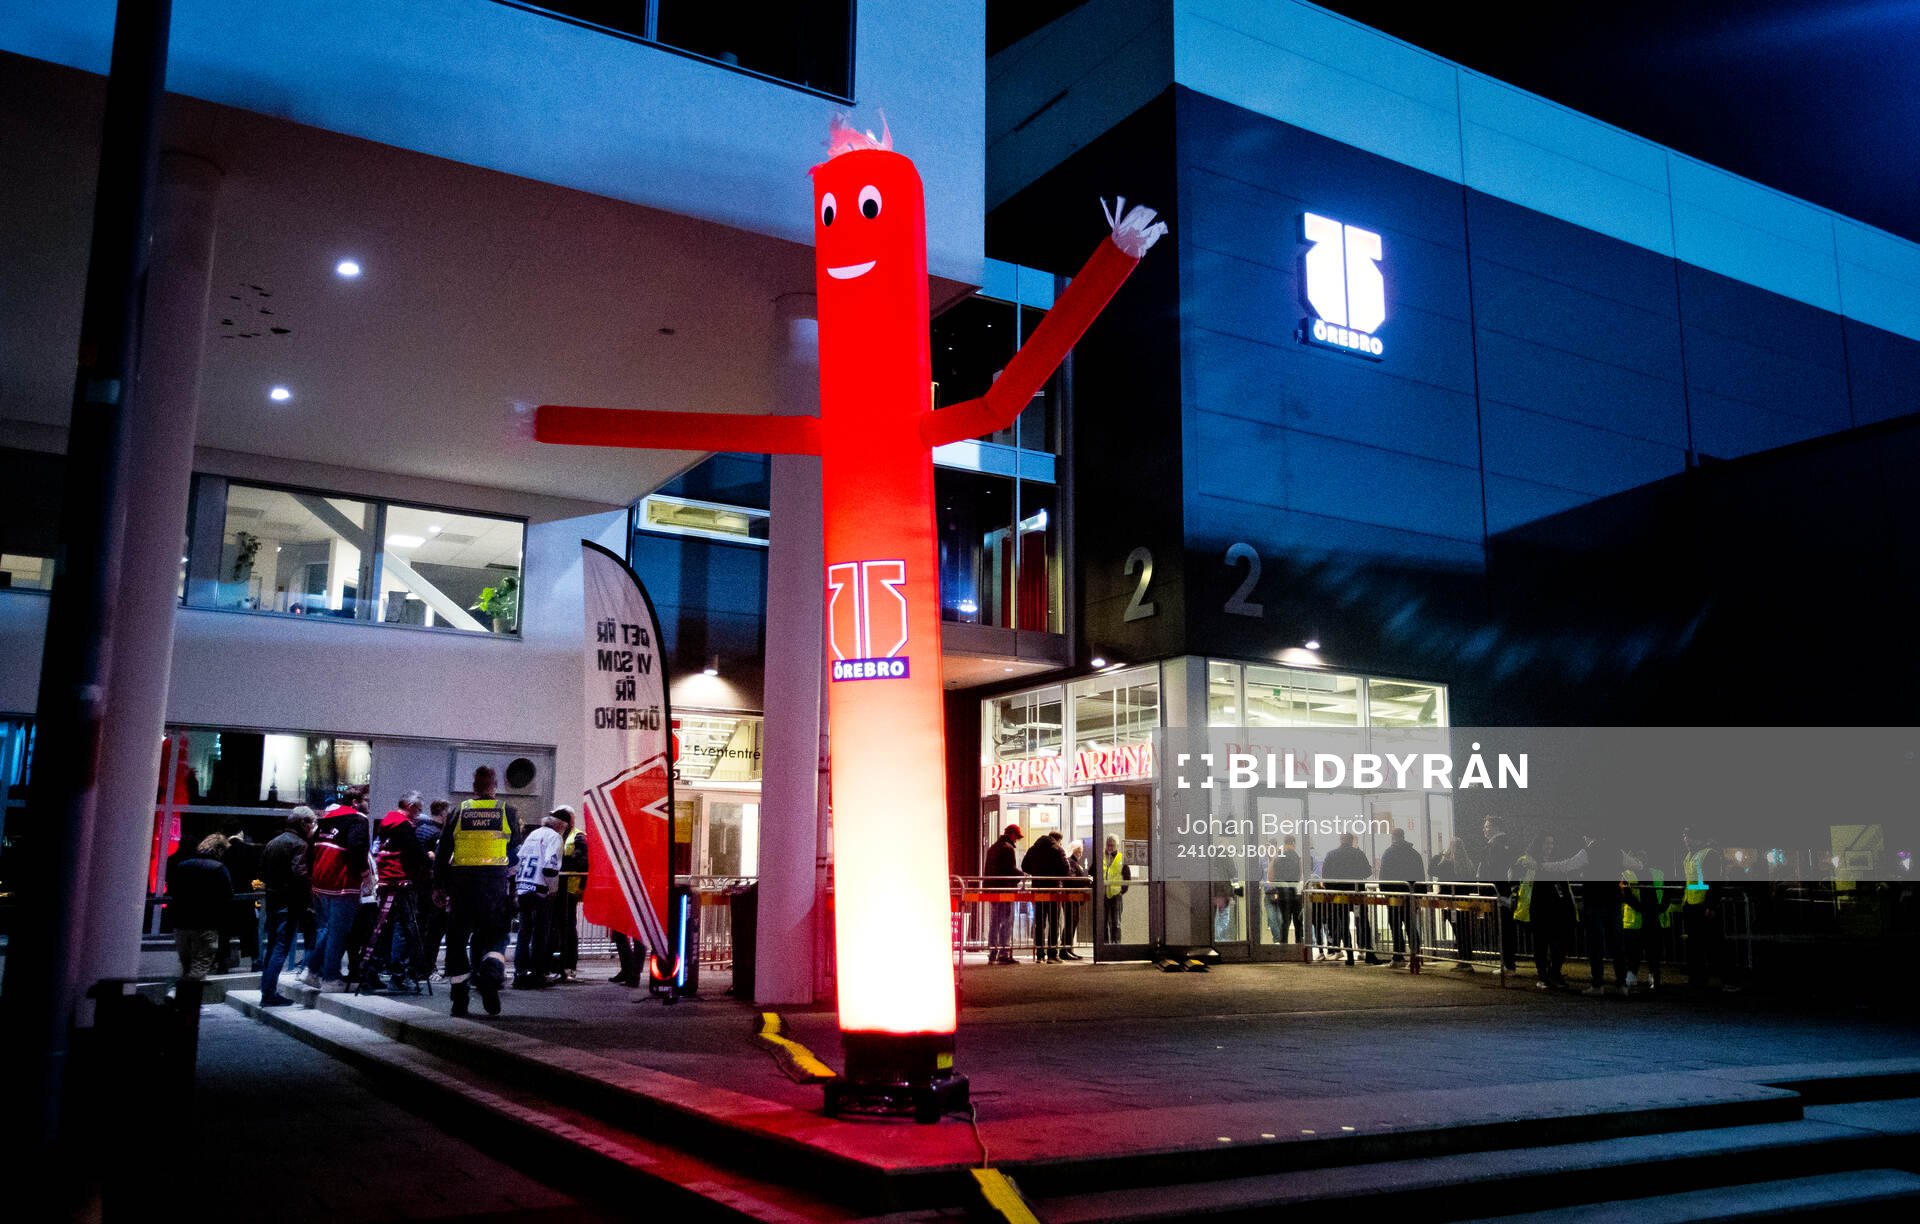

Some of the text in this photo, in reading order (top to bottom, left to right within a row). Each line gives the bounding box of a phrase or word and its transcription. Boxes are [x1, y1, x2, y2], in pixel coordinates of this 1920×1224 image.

[1313, 319, 1383, 355] ÖREBRO
[1124, 546, 1154, 622] 2
[1224, 543, 1264, 618] 2
[834, 661, 904, 680] ÖREBRO
[693, 745, 761, 760] Evententré
[986, 742, 1160, 791] BEHRN ARENA
[463, 811, 500, 819] ORDNINGS
